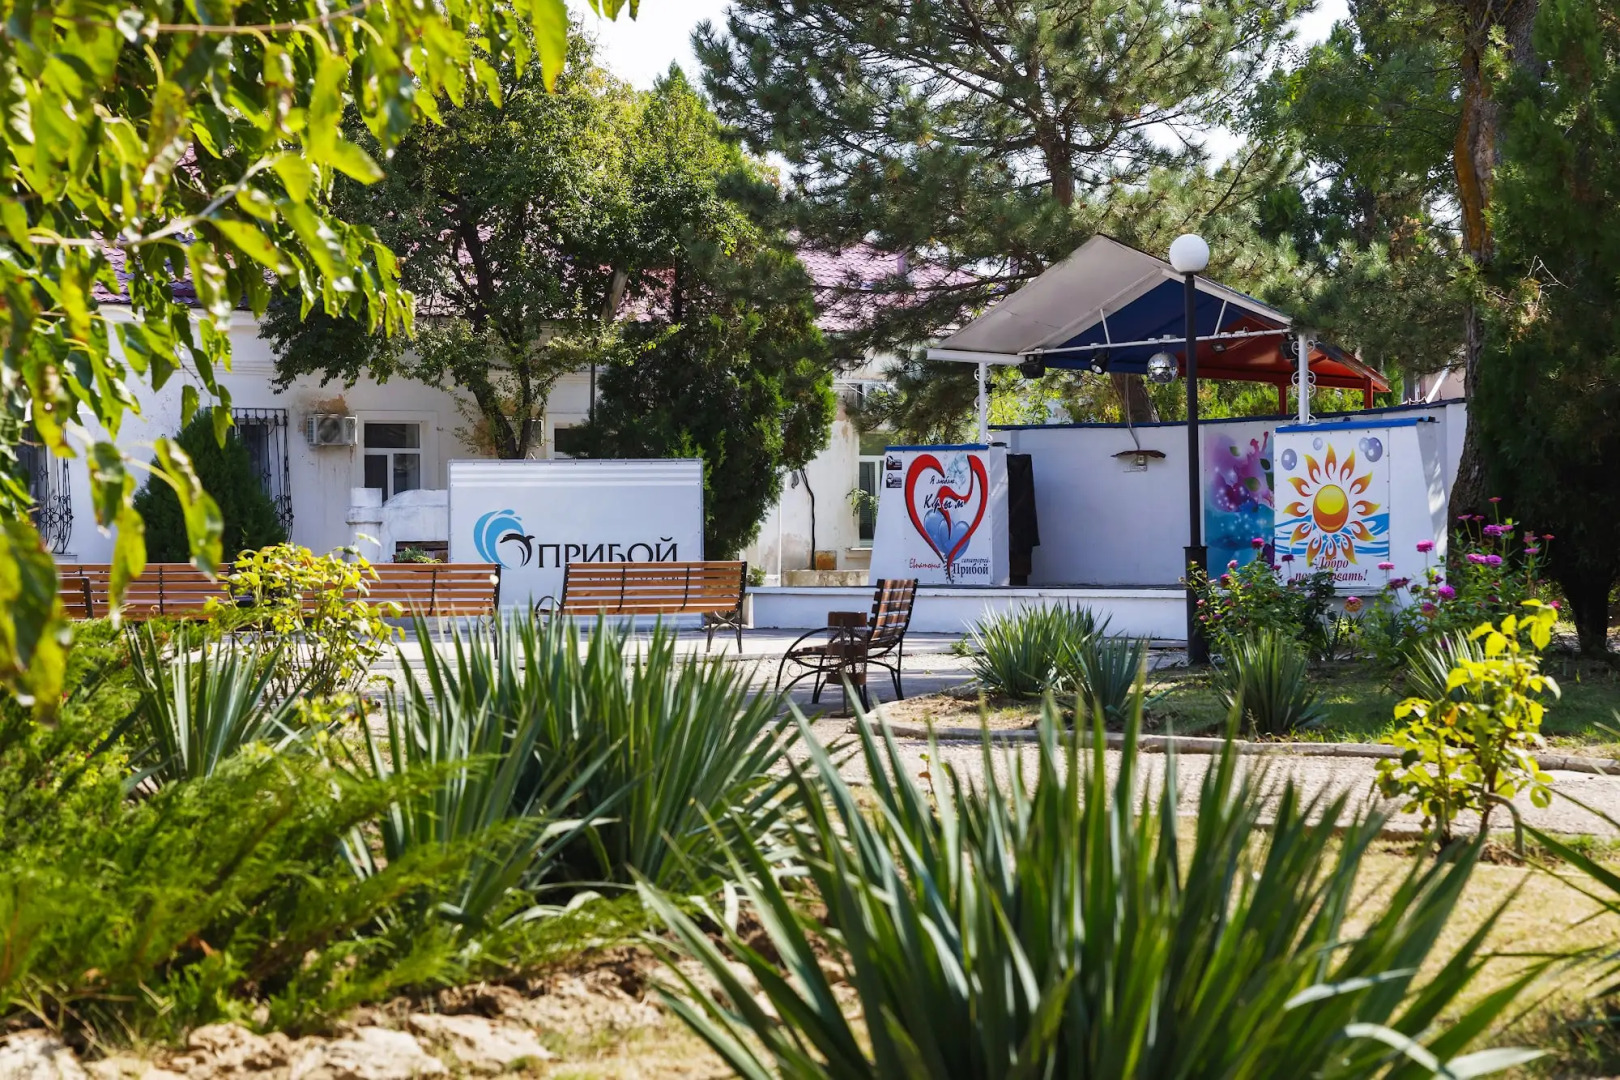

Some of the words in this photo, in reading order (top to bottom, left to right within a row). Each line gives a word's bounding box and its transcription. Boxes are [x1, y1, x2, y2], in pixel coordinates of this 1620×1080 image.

[929, 475, 935, 484] Я
[923, 494, 963, 512] Крым
[538, 536, 678, 567] ПРИБОЙ
[952, 563, 989, 577] Прибой
[1315, 556, 1349, 571] Добро
